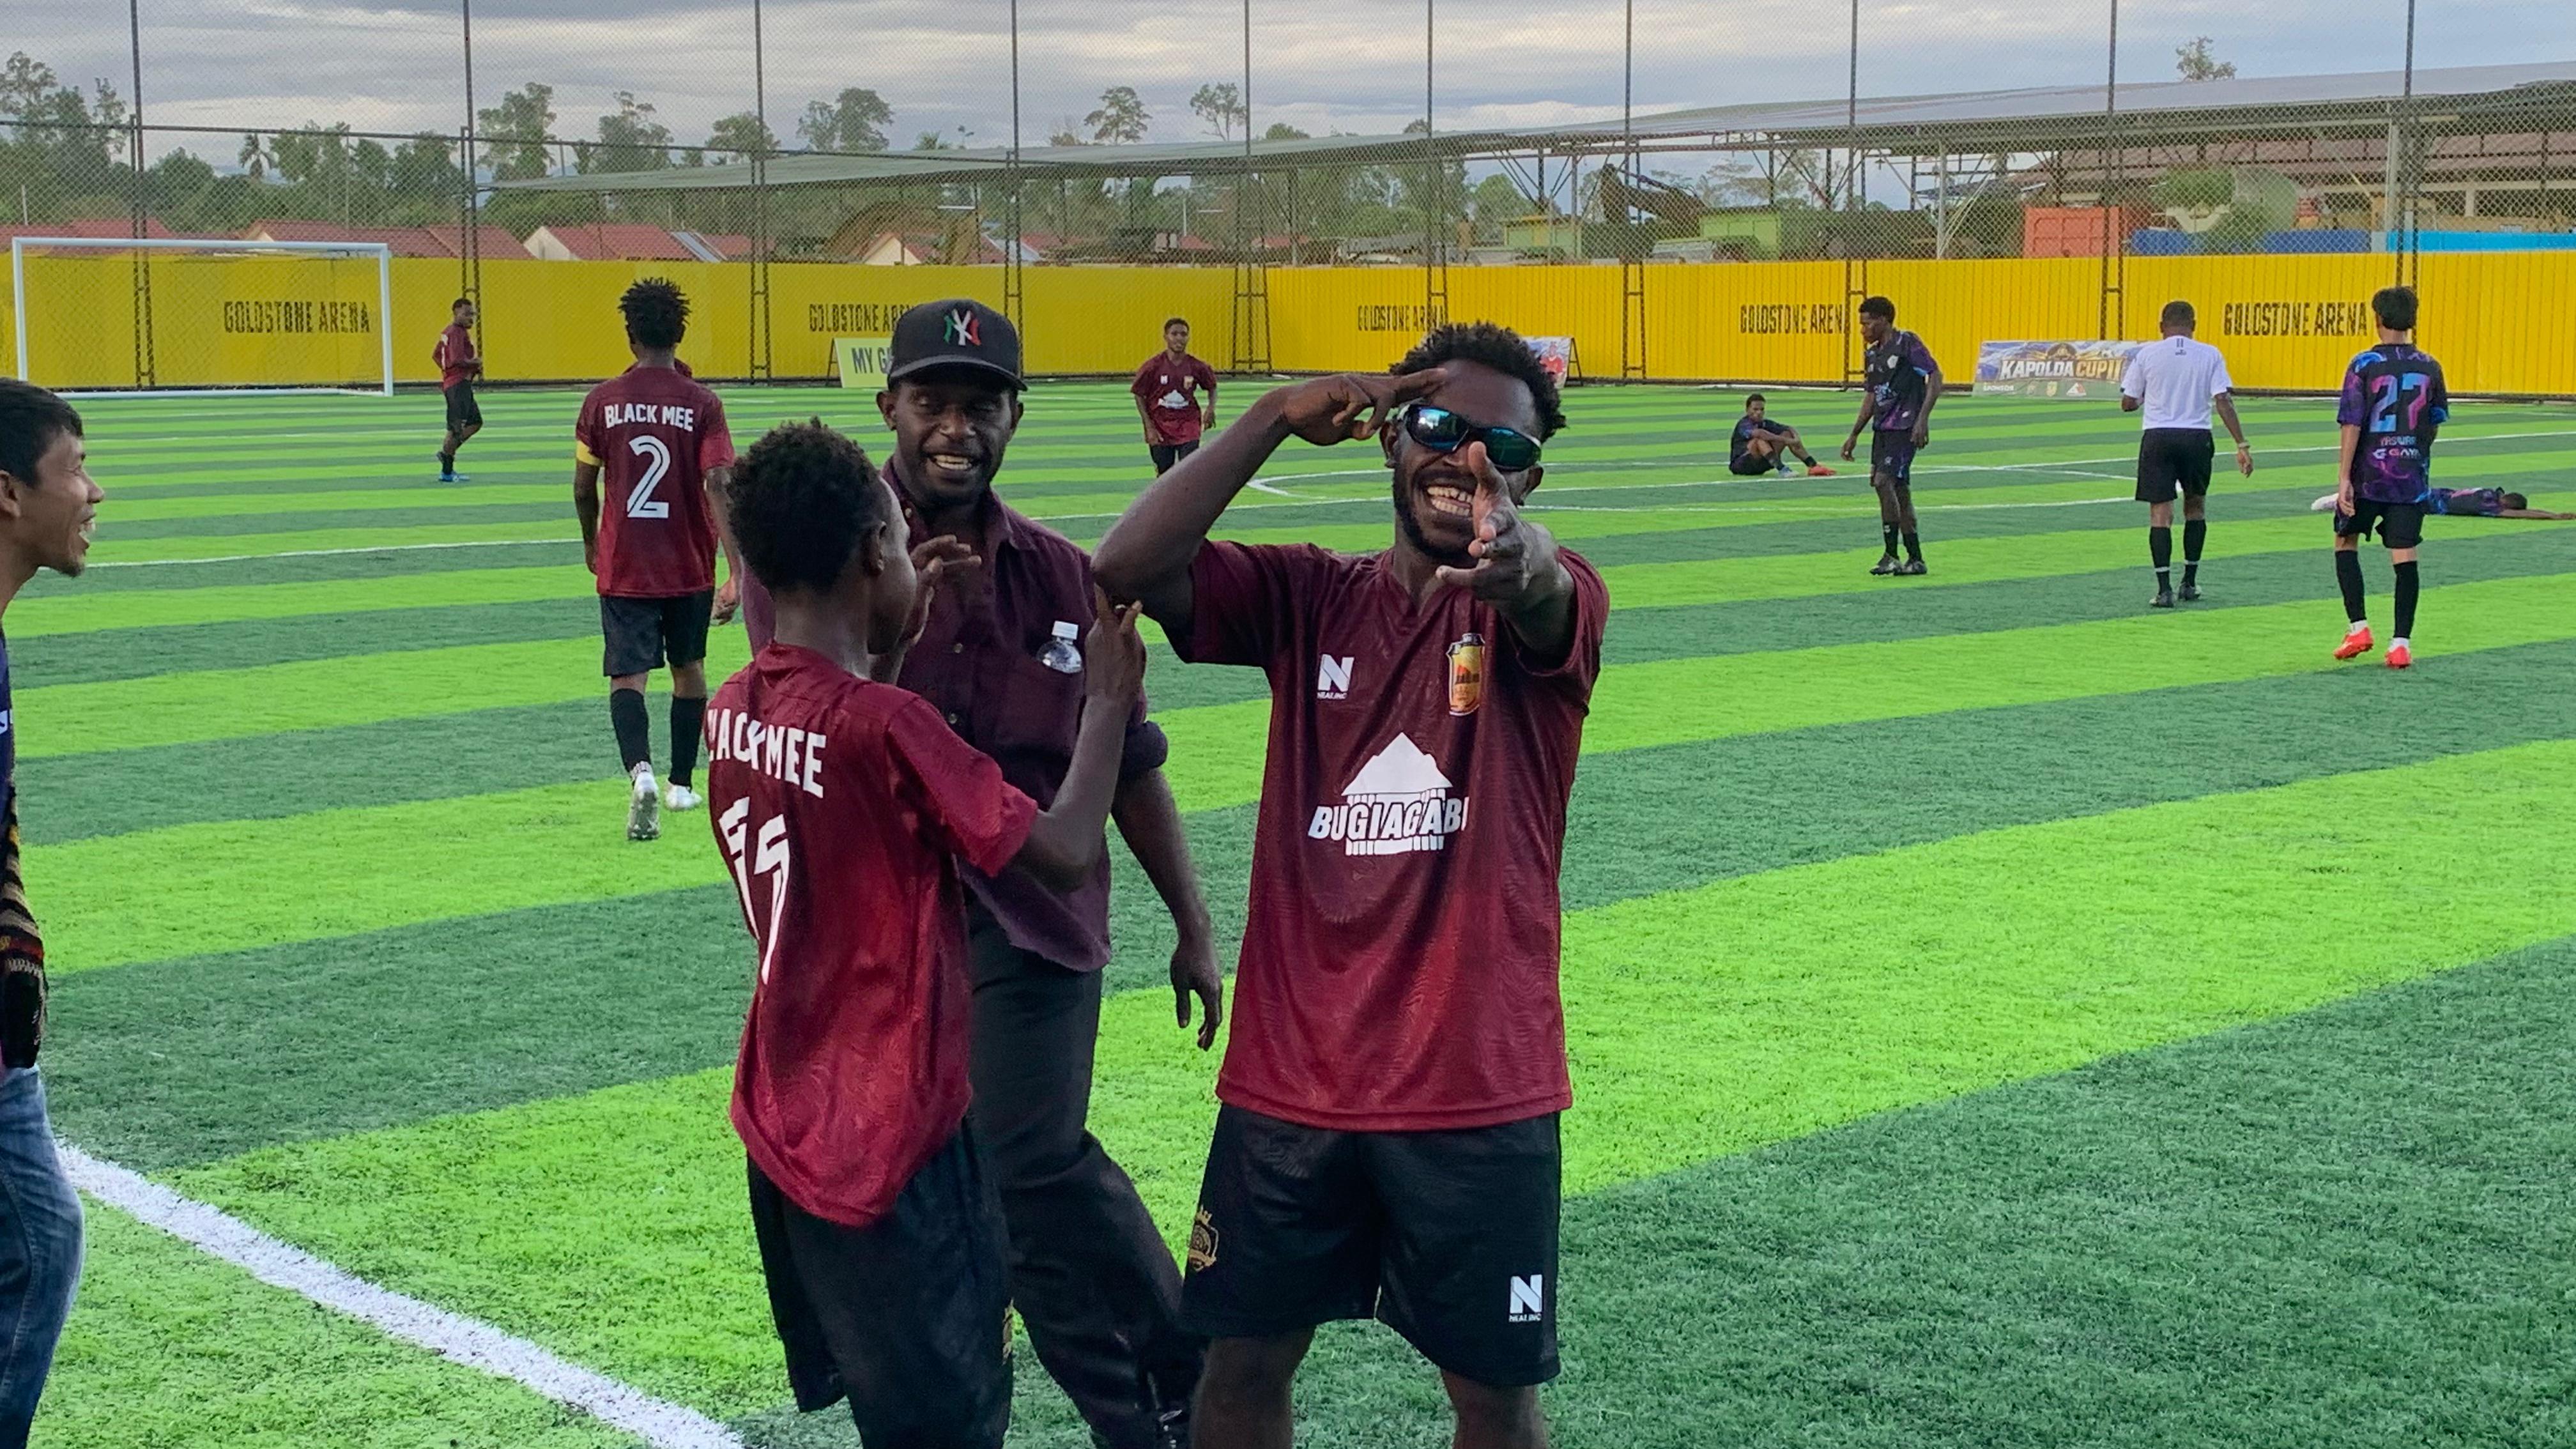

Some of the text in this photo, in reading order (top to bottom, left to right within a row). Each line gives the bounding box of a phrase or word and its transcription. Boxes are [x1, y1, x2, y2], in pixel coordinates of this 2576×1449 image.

[224, 301, 370, 333] GOLDSTONE ARENA
[809, 303, 878, 332] GOLDSTONE
[1358, 305, 1409, 331] GOLDSTONE
[1740, 304, 1848, 334] GOLDSTONE AREN
[2224, 302, 2367, 336] GOLDSTONE ARENA
[851, 347, 873, 374] MY
[1999, 360, 2074, 380] KAPOLDA
[604, 403, 694, 432] BLACK MEE
[2370, 372, 2430, 433] 27
[627, 435, 671, 519] 2
[1318, 654, 1354, 692] N
[707, 709, 827, 799] ACK MEE
[1509, 1274, 1542, 1314] N
